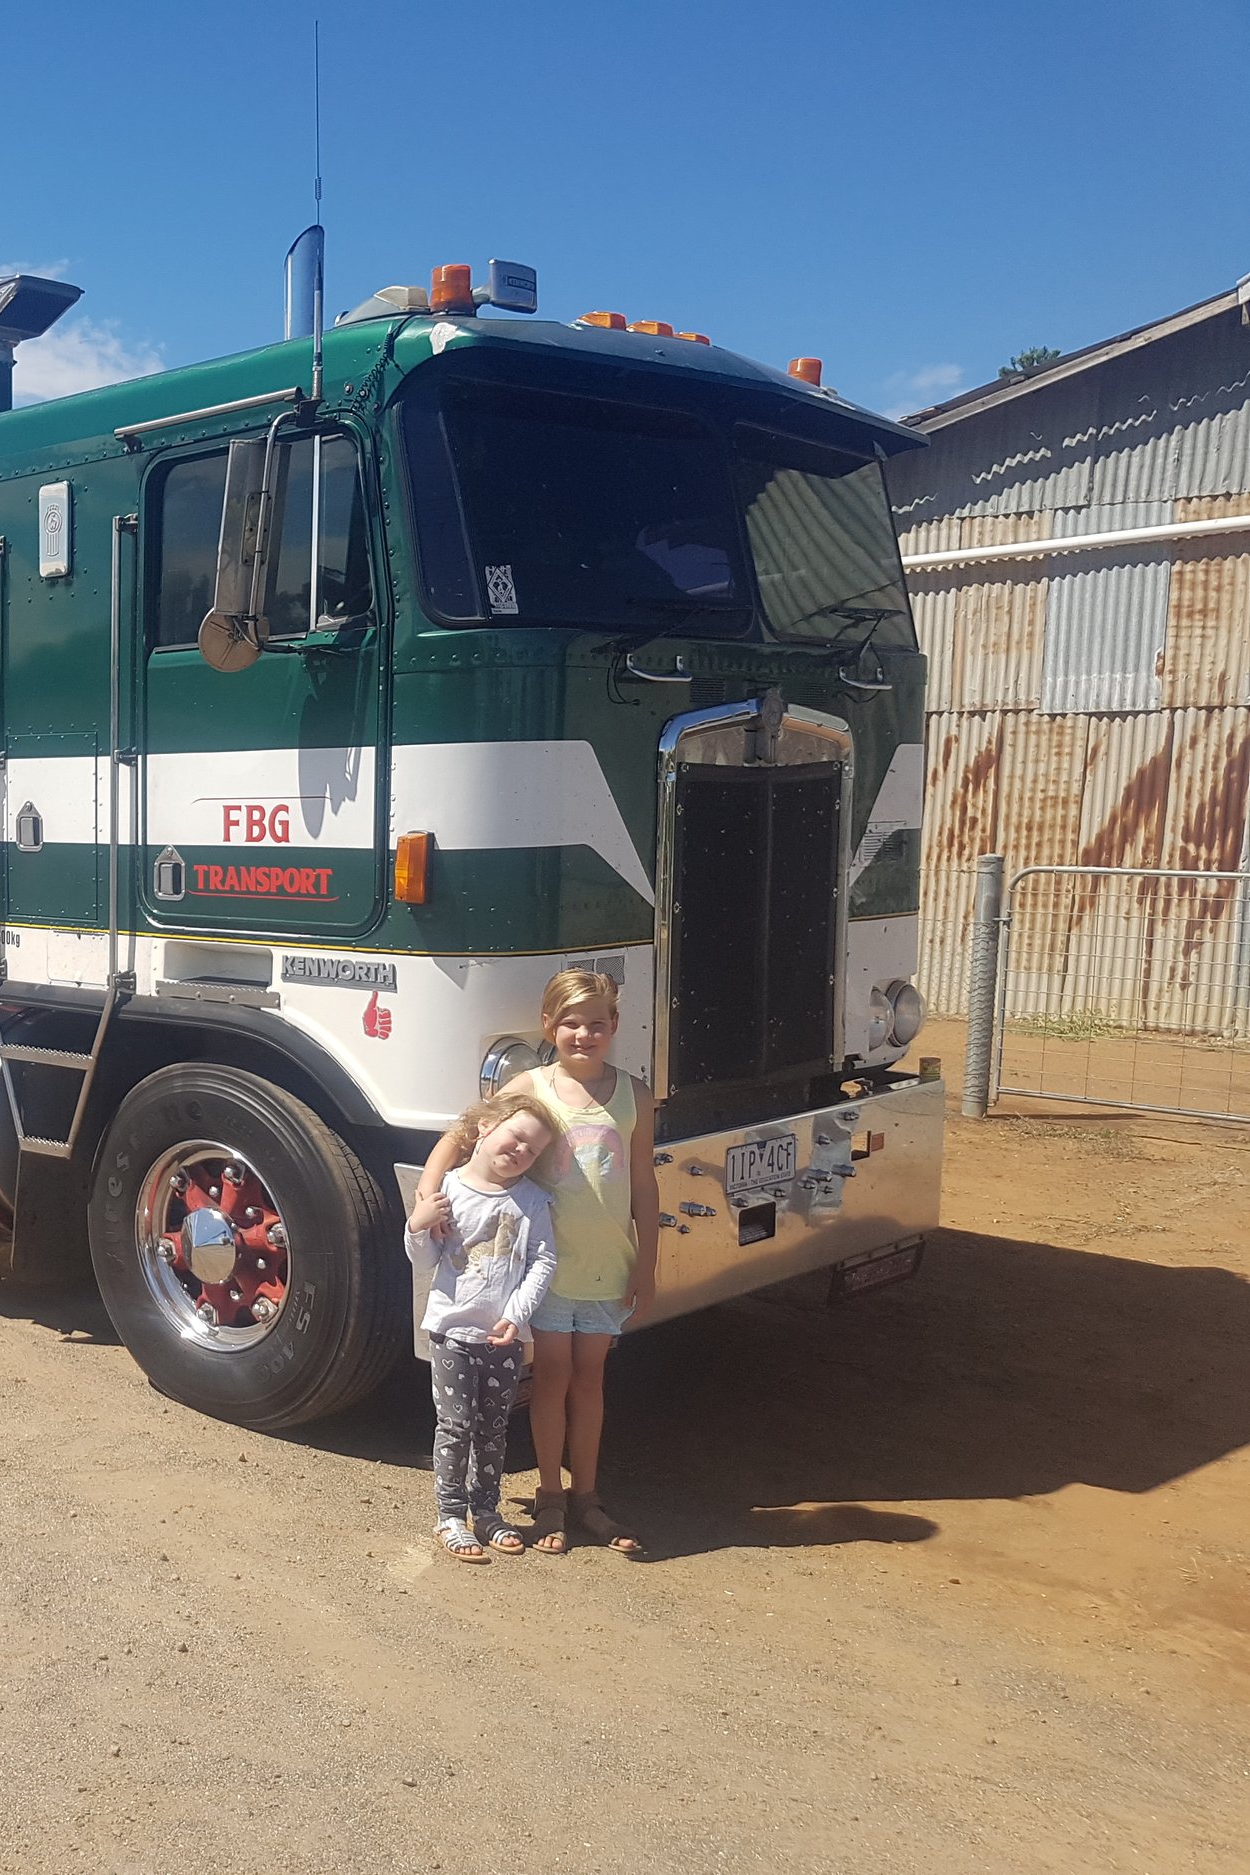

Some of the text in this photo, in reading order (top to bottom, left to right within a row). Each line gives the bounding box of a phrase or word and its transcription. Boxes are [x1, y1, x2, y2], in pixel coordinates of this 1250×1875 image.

[222, 804, 291, 843] FBG
[193, 864, 334, 895] TRANSPORT
[281, 955, 397, 986] KENWORTH
